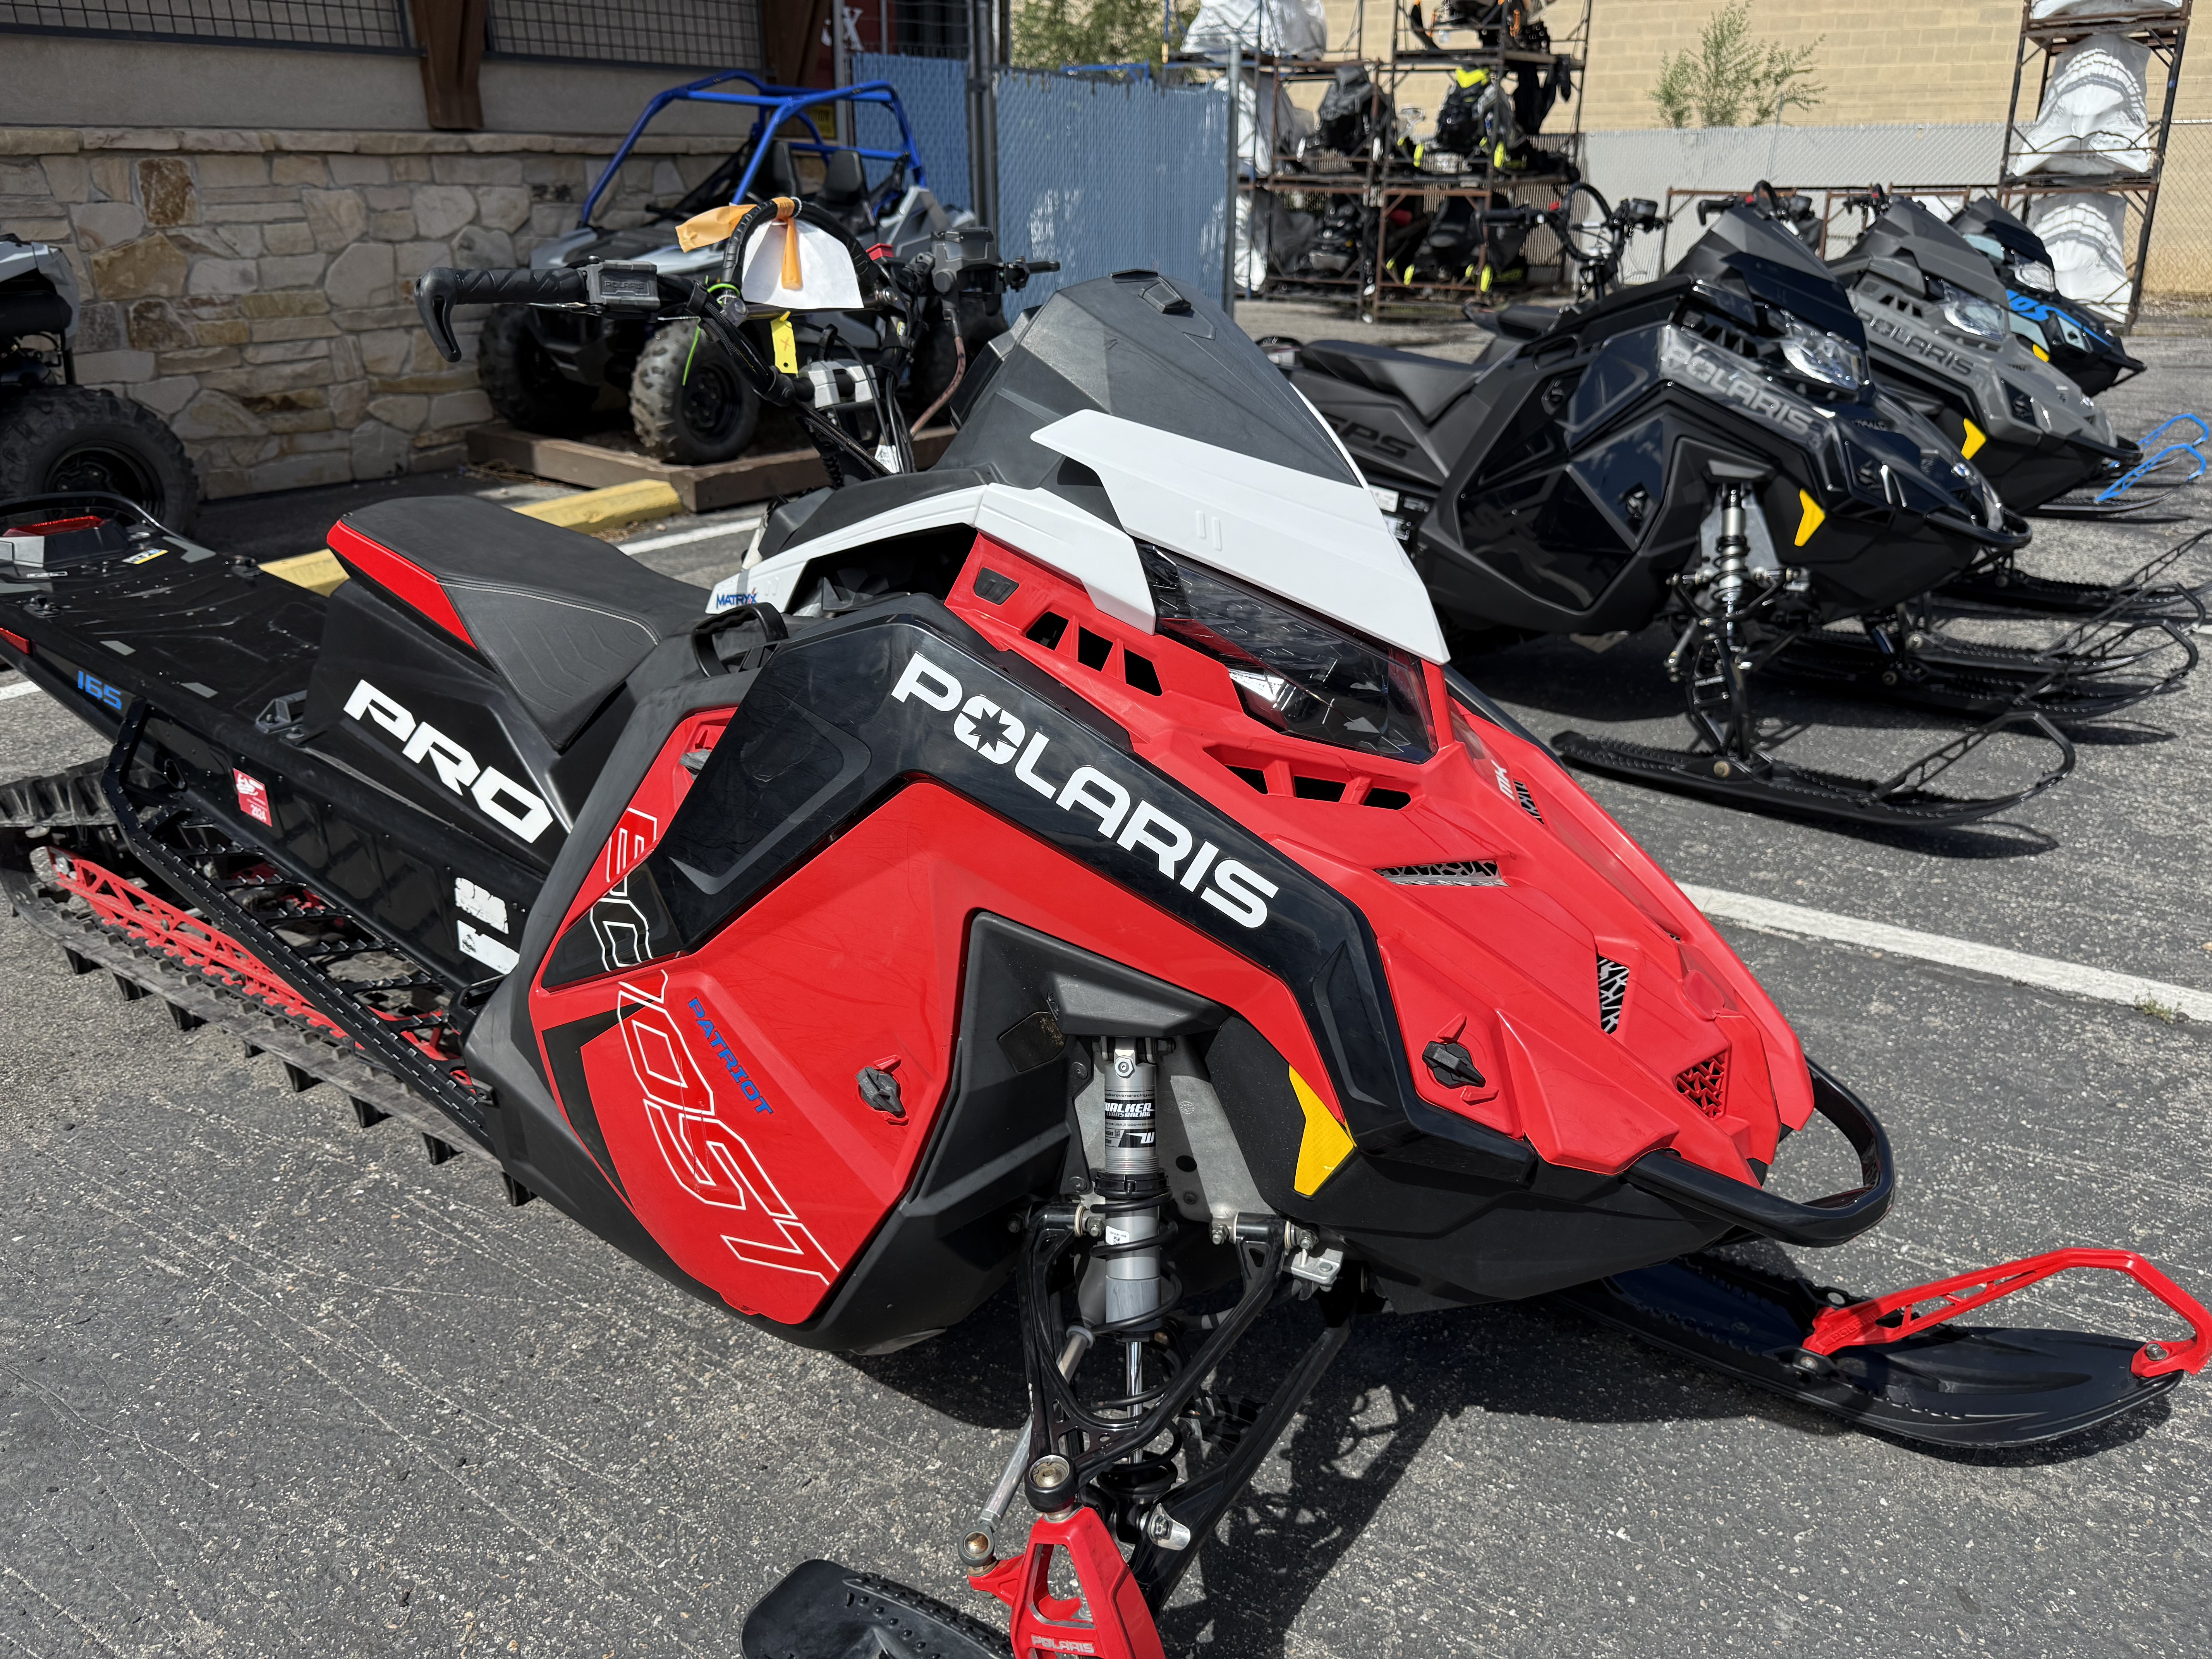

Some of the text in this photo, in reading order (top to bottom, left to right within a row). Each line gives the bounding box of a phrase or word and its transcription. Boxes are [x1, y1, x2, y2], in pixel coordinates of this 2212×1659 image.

[604, 280, 645, 290] POLARIS
[1664, 344, 1815, 436] POLARIS
[716, 587, 758, 609] MATRYX
[77, 670, 122, 710] 165
[343, 679, 553, 844] PRO
[891, 651, 1279, 929] POLARIS
[688, 998, 773, 1115] PATRIOT
[1104, 1102, 1155, 1113] WALKER
[1031, 1635, 1095, 1654] POLARIS
